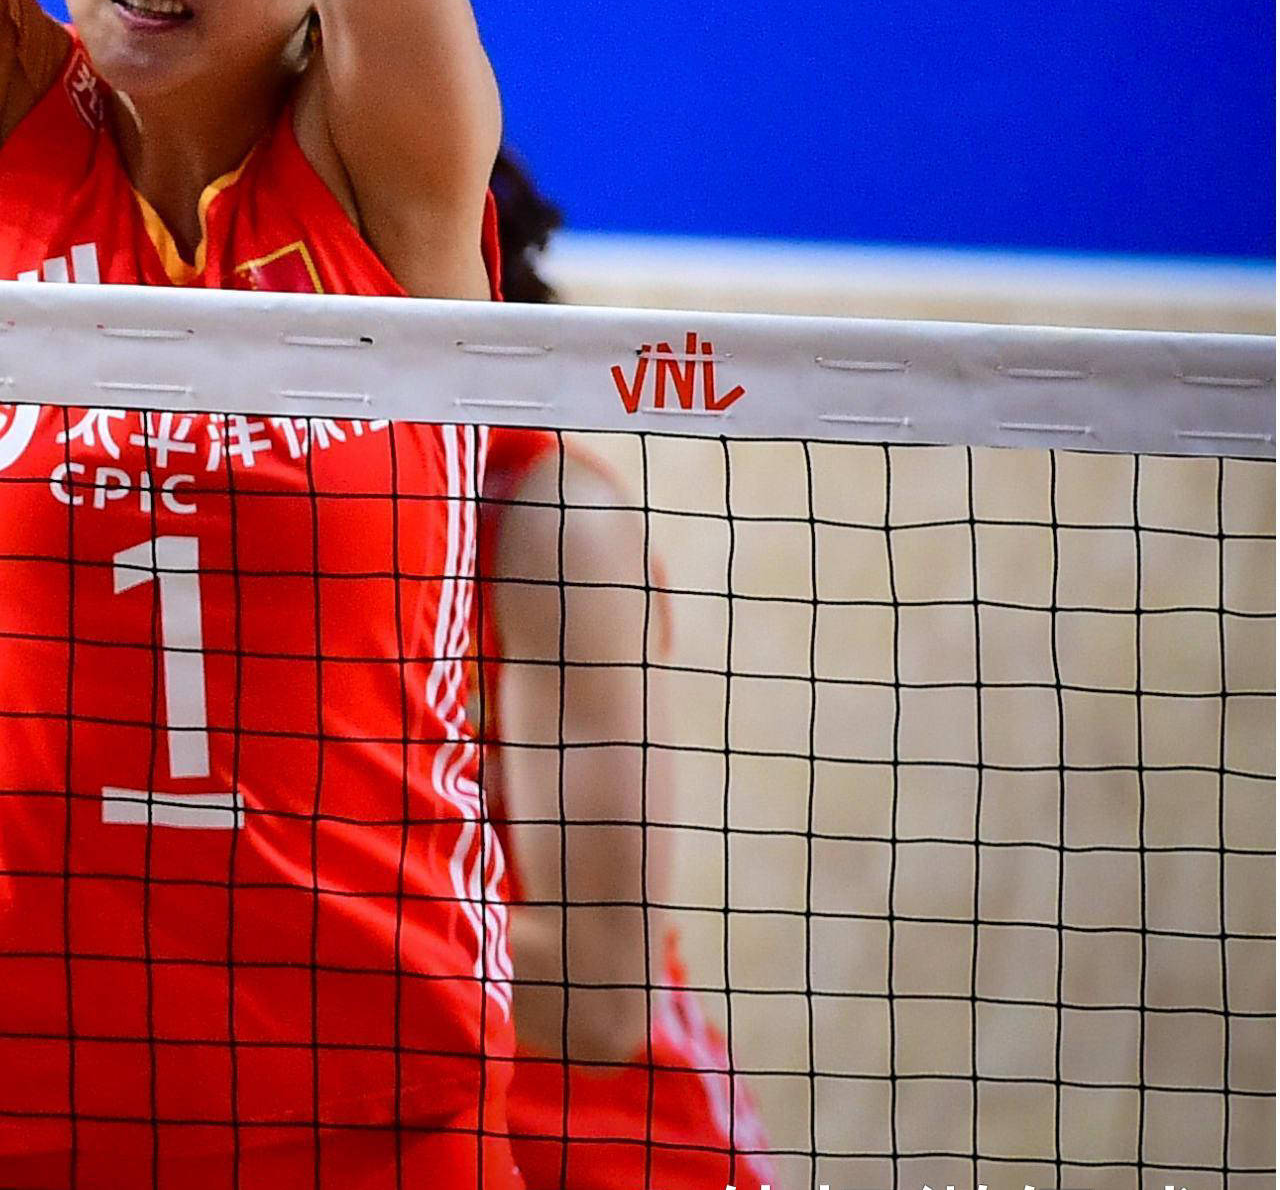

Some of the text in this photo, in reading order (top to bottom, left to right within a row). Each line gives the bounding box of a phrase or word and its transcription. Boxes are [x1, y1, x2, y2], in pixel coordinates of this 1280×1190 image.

[610, 332, 746, 414] VNL
[54, 408, 390, 472] 太平洋保
[49, 461, 198, 515] CPIC
[112, 535, 210, 778] 1
